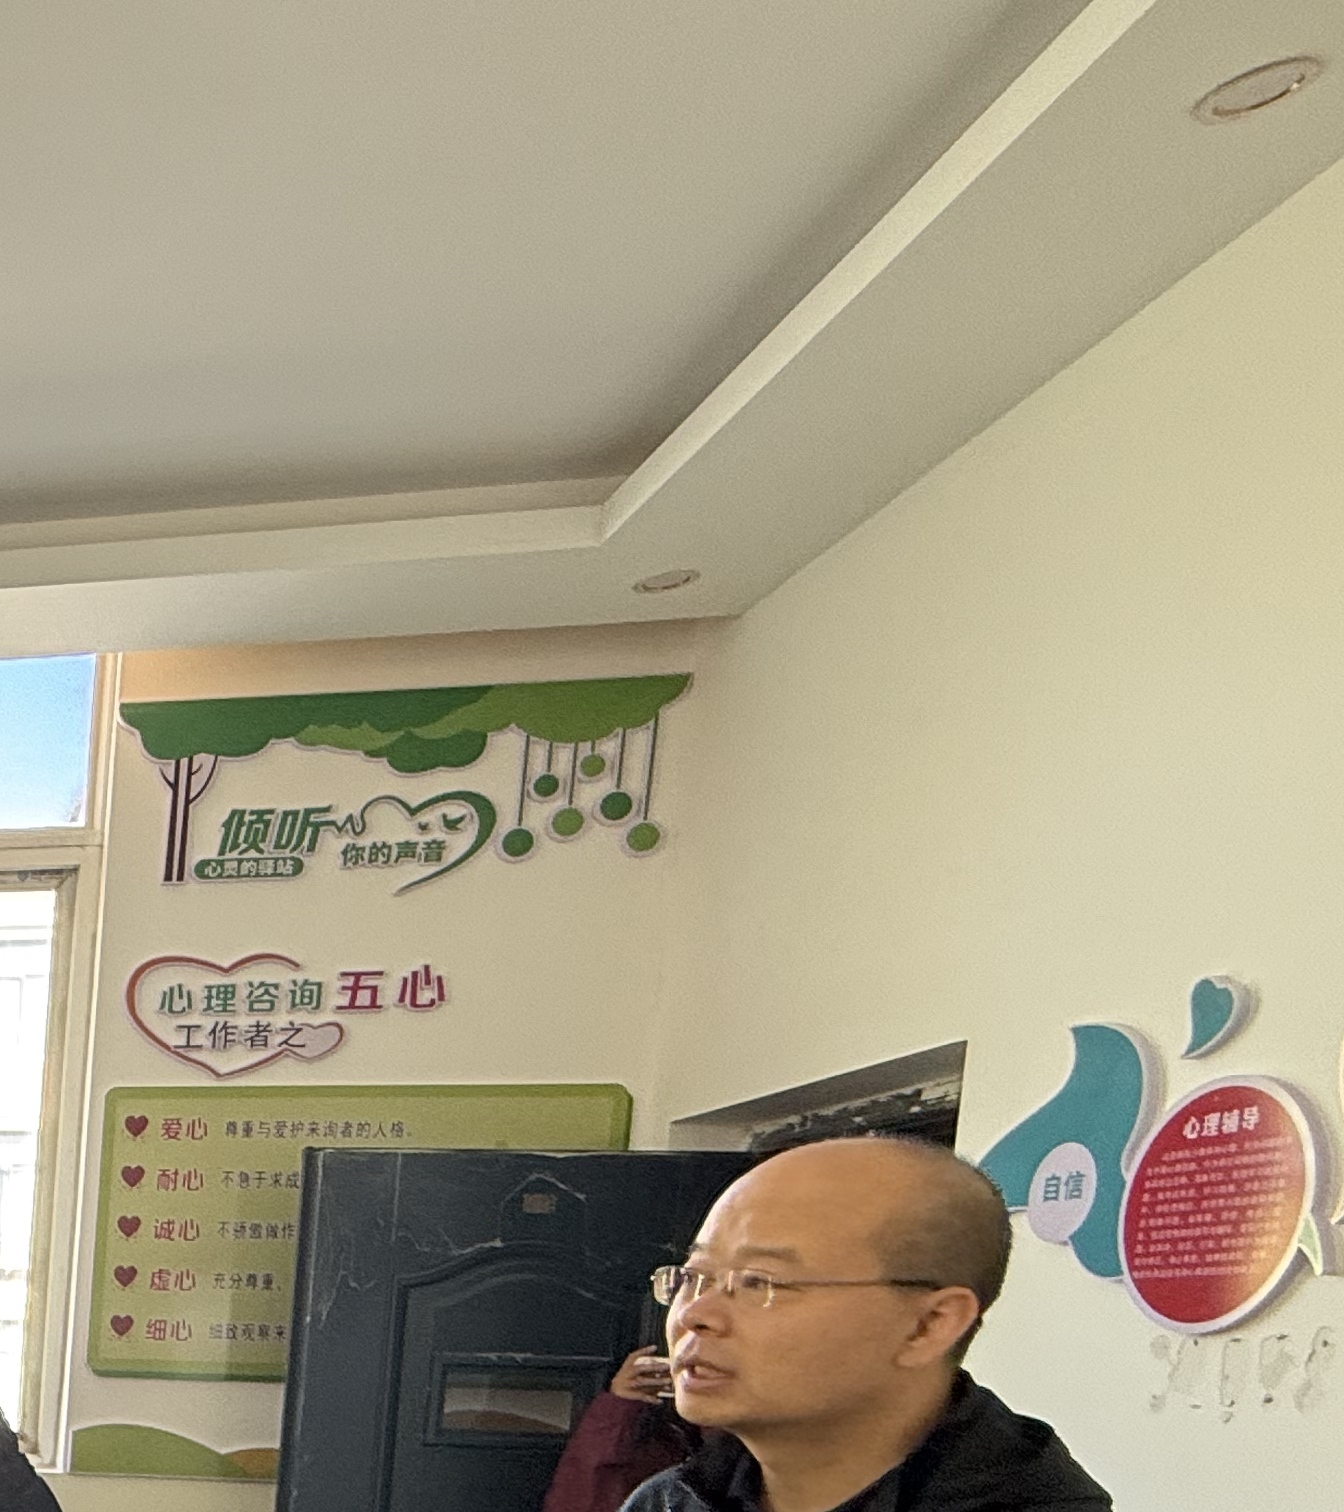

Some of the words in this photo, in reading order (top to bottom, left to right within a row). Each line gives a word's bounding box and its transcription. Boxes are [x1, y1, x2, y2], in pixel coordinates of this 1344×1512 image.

[217, 804, 332, 857] 倾听
[340, 838, 448, 867] 你的声音
[202, 858, 295, 878] 心灵的驿站
[158, 978, 324, 1015] 心理咨询
[335, 964, 446, 1011] 五心
[172, 1020, 308, 1050] 工作者之
[160, 1117, 209, 1141] 爱心
[1182, 1105, 1262, 1139] 心理辅导
[156, 1167, 205, 1193] 耐心
[1042, 1170, 1087, 1203] 自信
[152, 1217, 200, 1242] 诚心
[149, 1267, 197, 1292] 虚心
[144, 1318, 193, 1343] 细心
